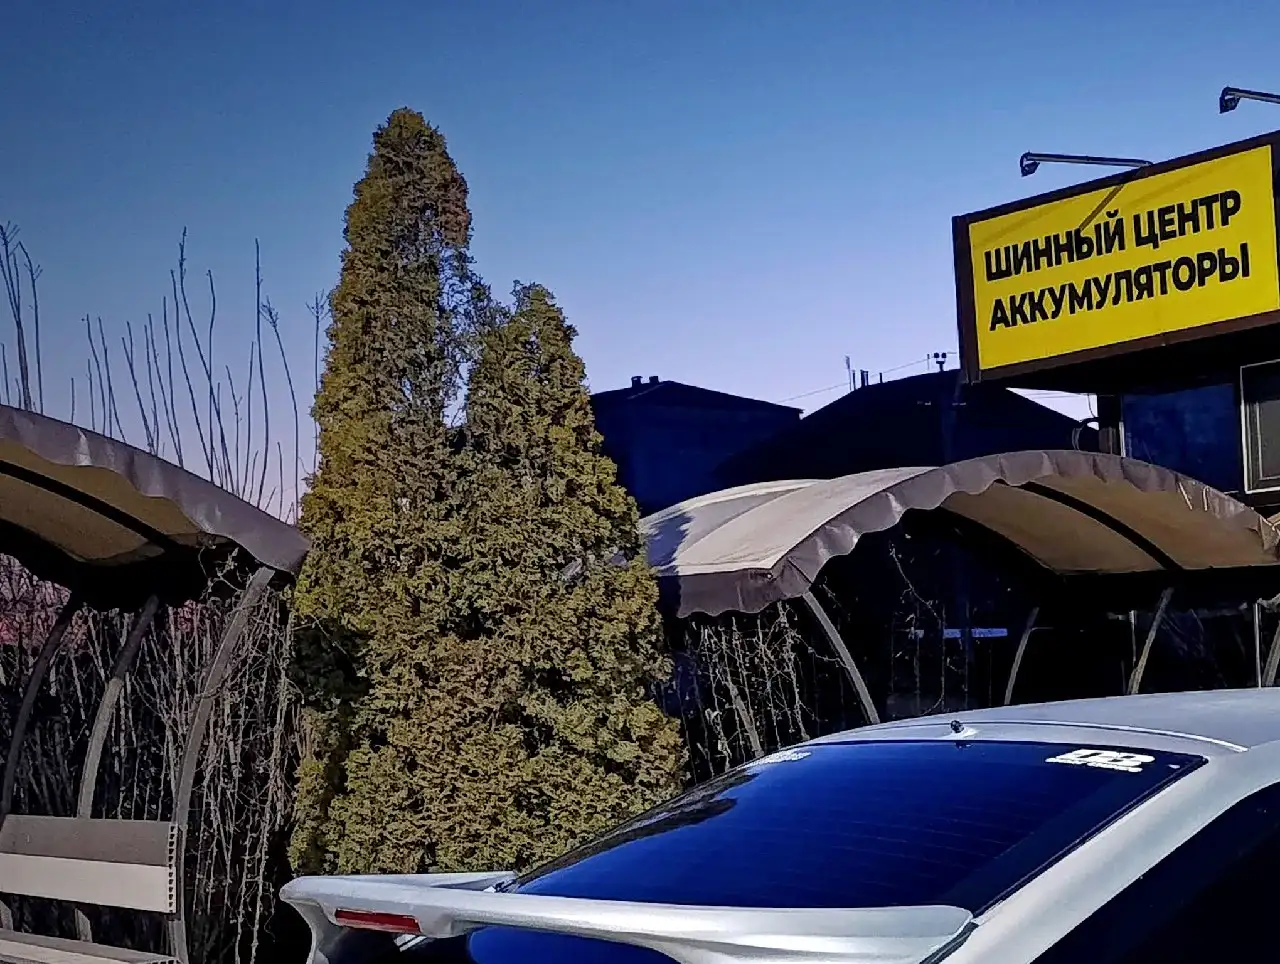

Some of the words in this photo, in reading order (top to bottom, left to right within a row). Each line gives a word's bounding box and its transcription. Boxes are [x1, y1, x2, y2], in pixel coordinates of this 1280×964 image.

[984, 209, 1126, 281] ШИННЫЙ
[1133, 190, 1241, 250] ЦЕНТР
[989, 242, 1250, 331] АККУМУЛЯТОРЫ
